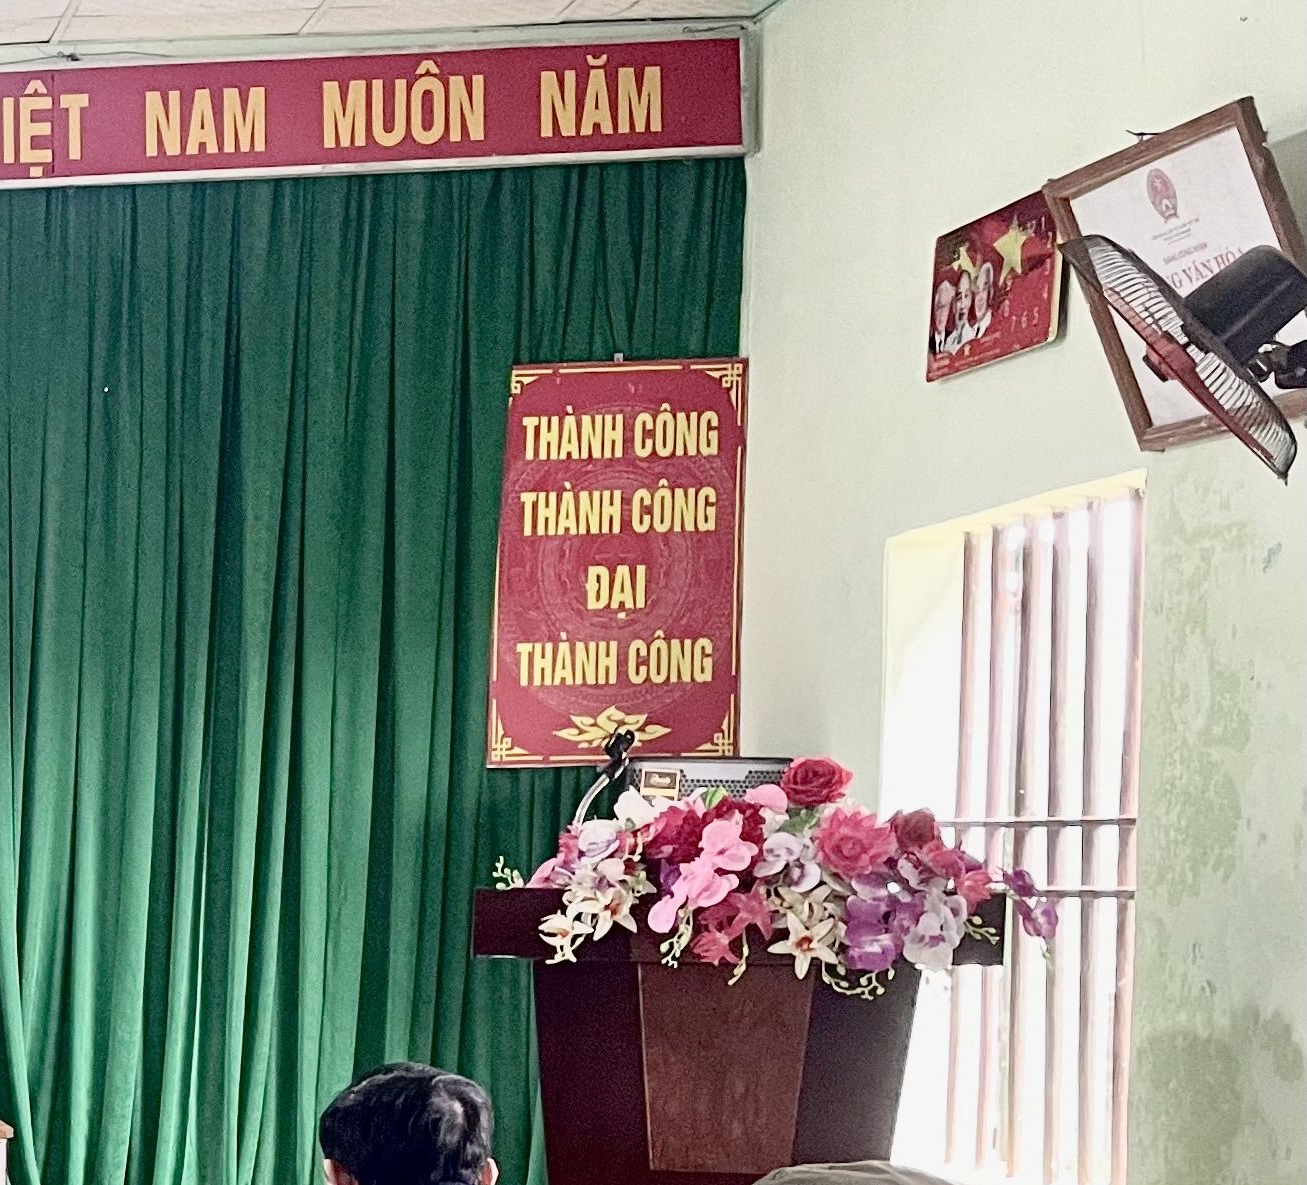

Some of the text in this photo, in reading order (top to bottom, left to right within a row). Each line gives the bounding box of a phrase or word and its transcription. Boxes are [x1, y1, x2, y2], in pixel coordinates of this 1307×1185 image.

[144, 86, 267, 158] NAM
[322, 60, 485, 149] MUÔN
[539, 54, 663, 138] NĂM
[1213, 246, 1245, 271] HÓ
[522, 403, 720, 461] THÀNH CÔNG
[520, 478, 717, 537] THÀNH CÔNG
[585, 564, 647, 620] ĐẠI
[516, 630, 714, 687] THÀNH CÔNG
